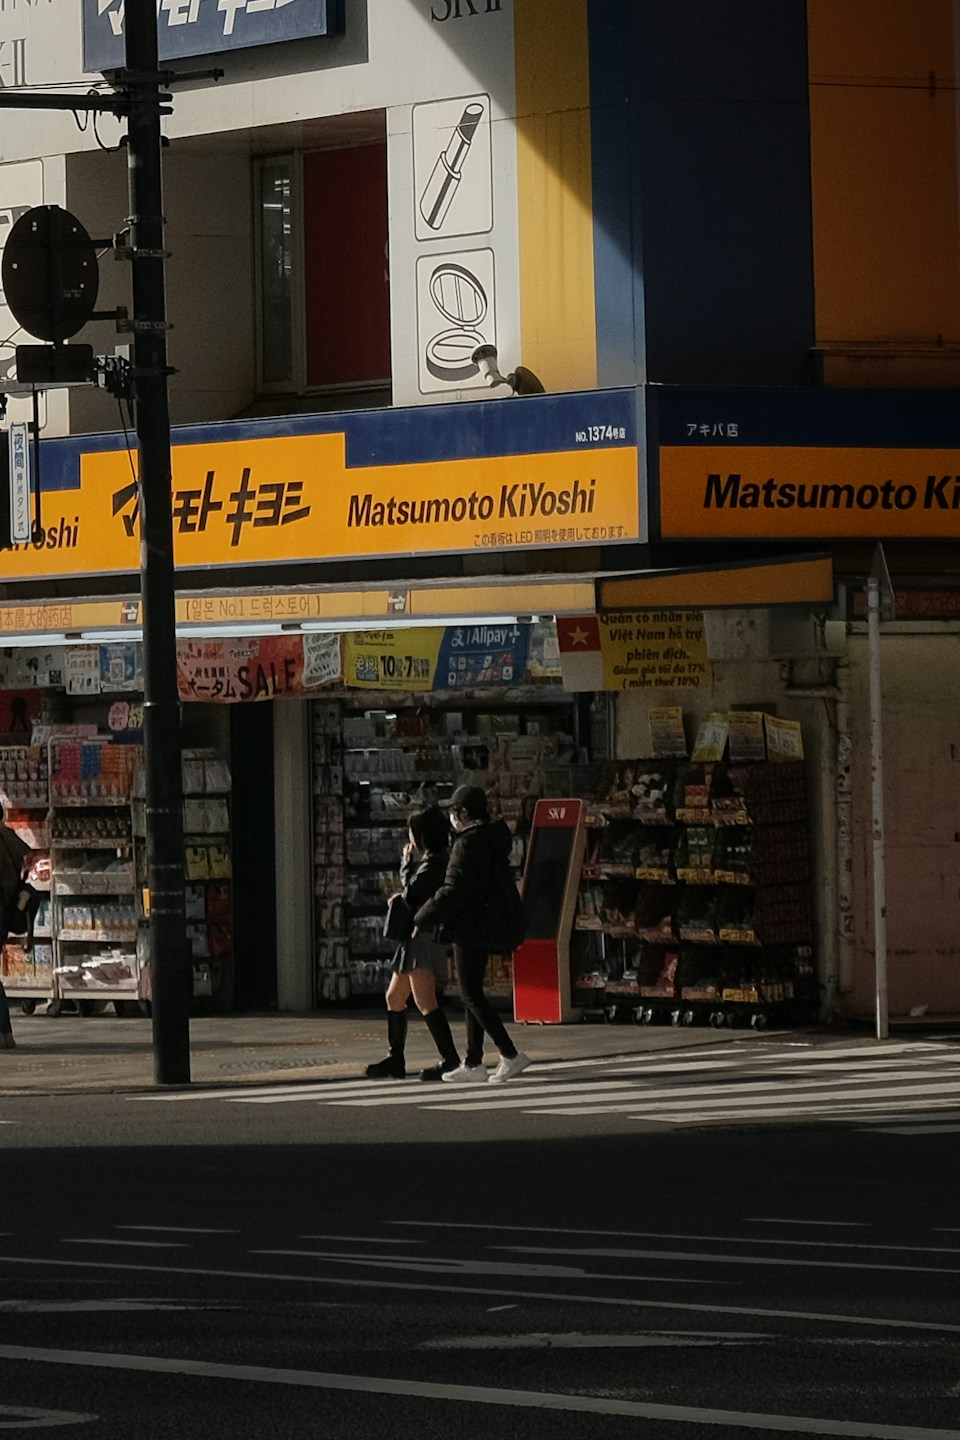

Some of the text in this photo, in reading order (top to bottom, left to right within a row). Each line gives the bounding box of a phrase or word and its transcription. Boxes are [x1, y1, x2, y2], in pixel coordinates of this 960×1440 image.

[686, 421, 740, 439] アキバ店
[111, 467, 311, 548] マモトキヨシ
[346, 478, 597, 529] Matsumoto KiYoshi
[702, 473, 918, 510] Matsumoto
[219, 598, 246, 618] No.1
[636, 628, 665, 640] Nam
[237, 658, 296, 699] SALE
